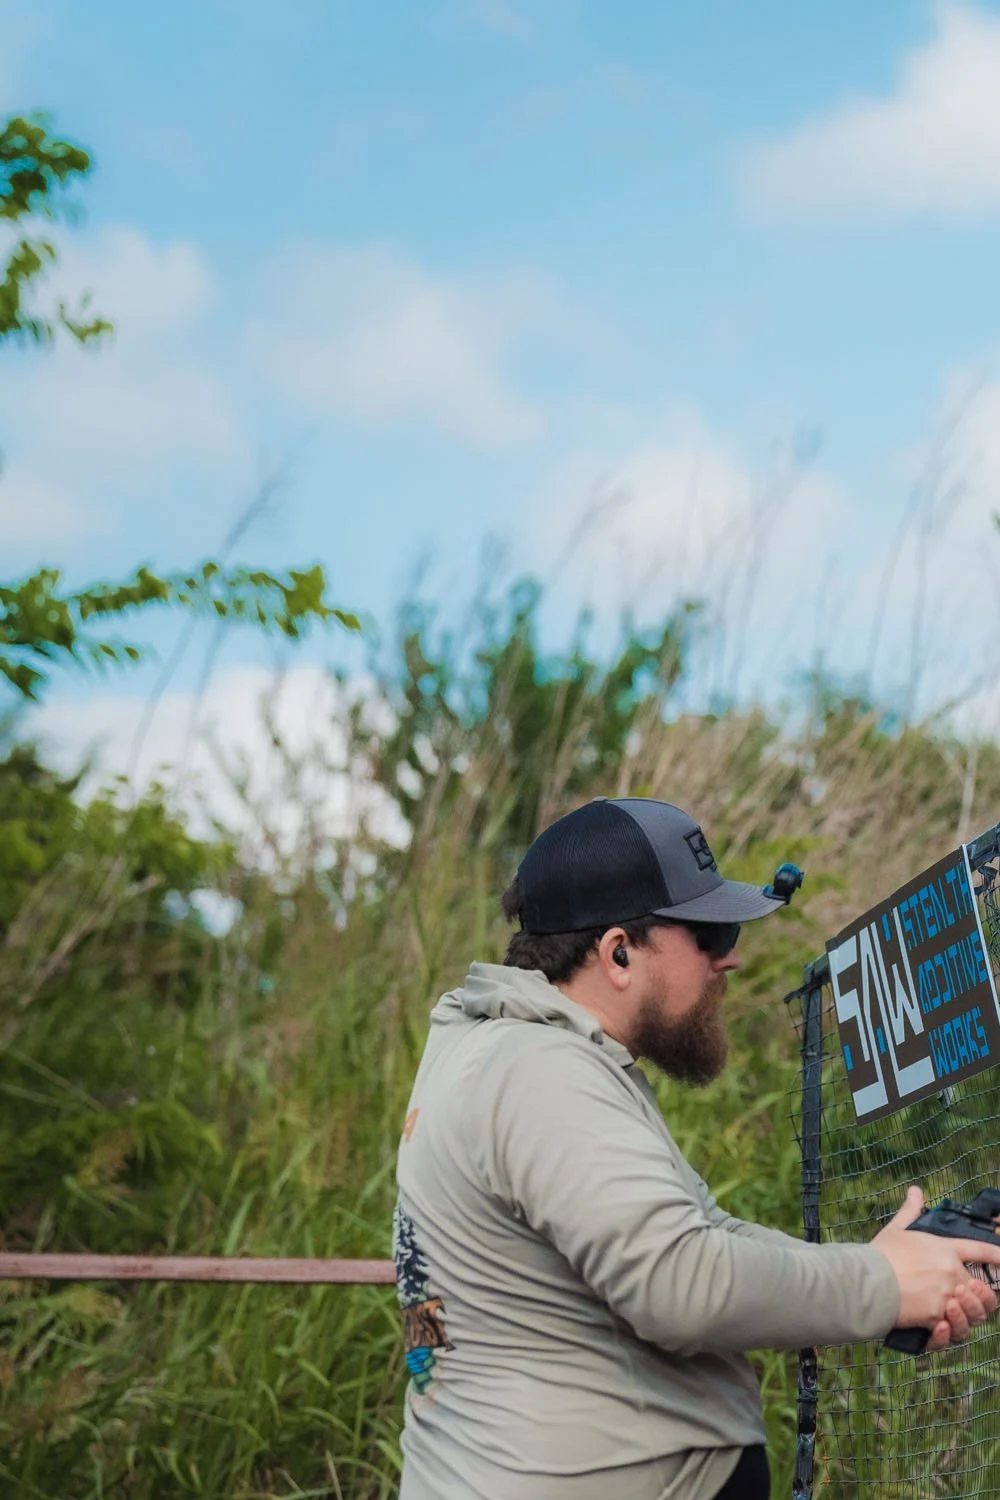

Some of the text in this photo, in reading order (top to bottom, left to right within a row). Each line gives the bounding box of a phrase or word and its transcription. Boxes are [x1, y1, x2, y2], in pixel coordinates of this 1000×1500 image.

[900, 863, 975, 951] STEALTH
[917, 932, 989, 1014] ADDITIVE
[928, 1006, 990, 1078] WORKS
